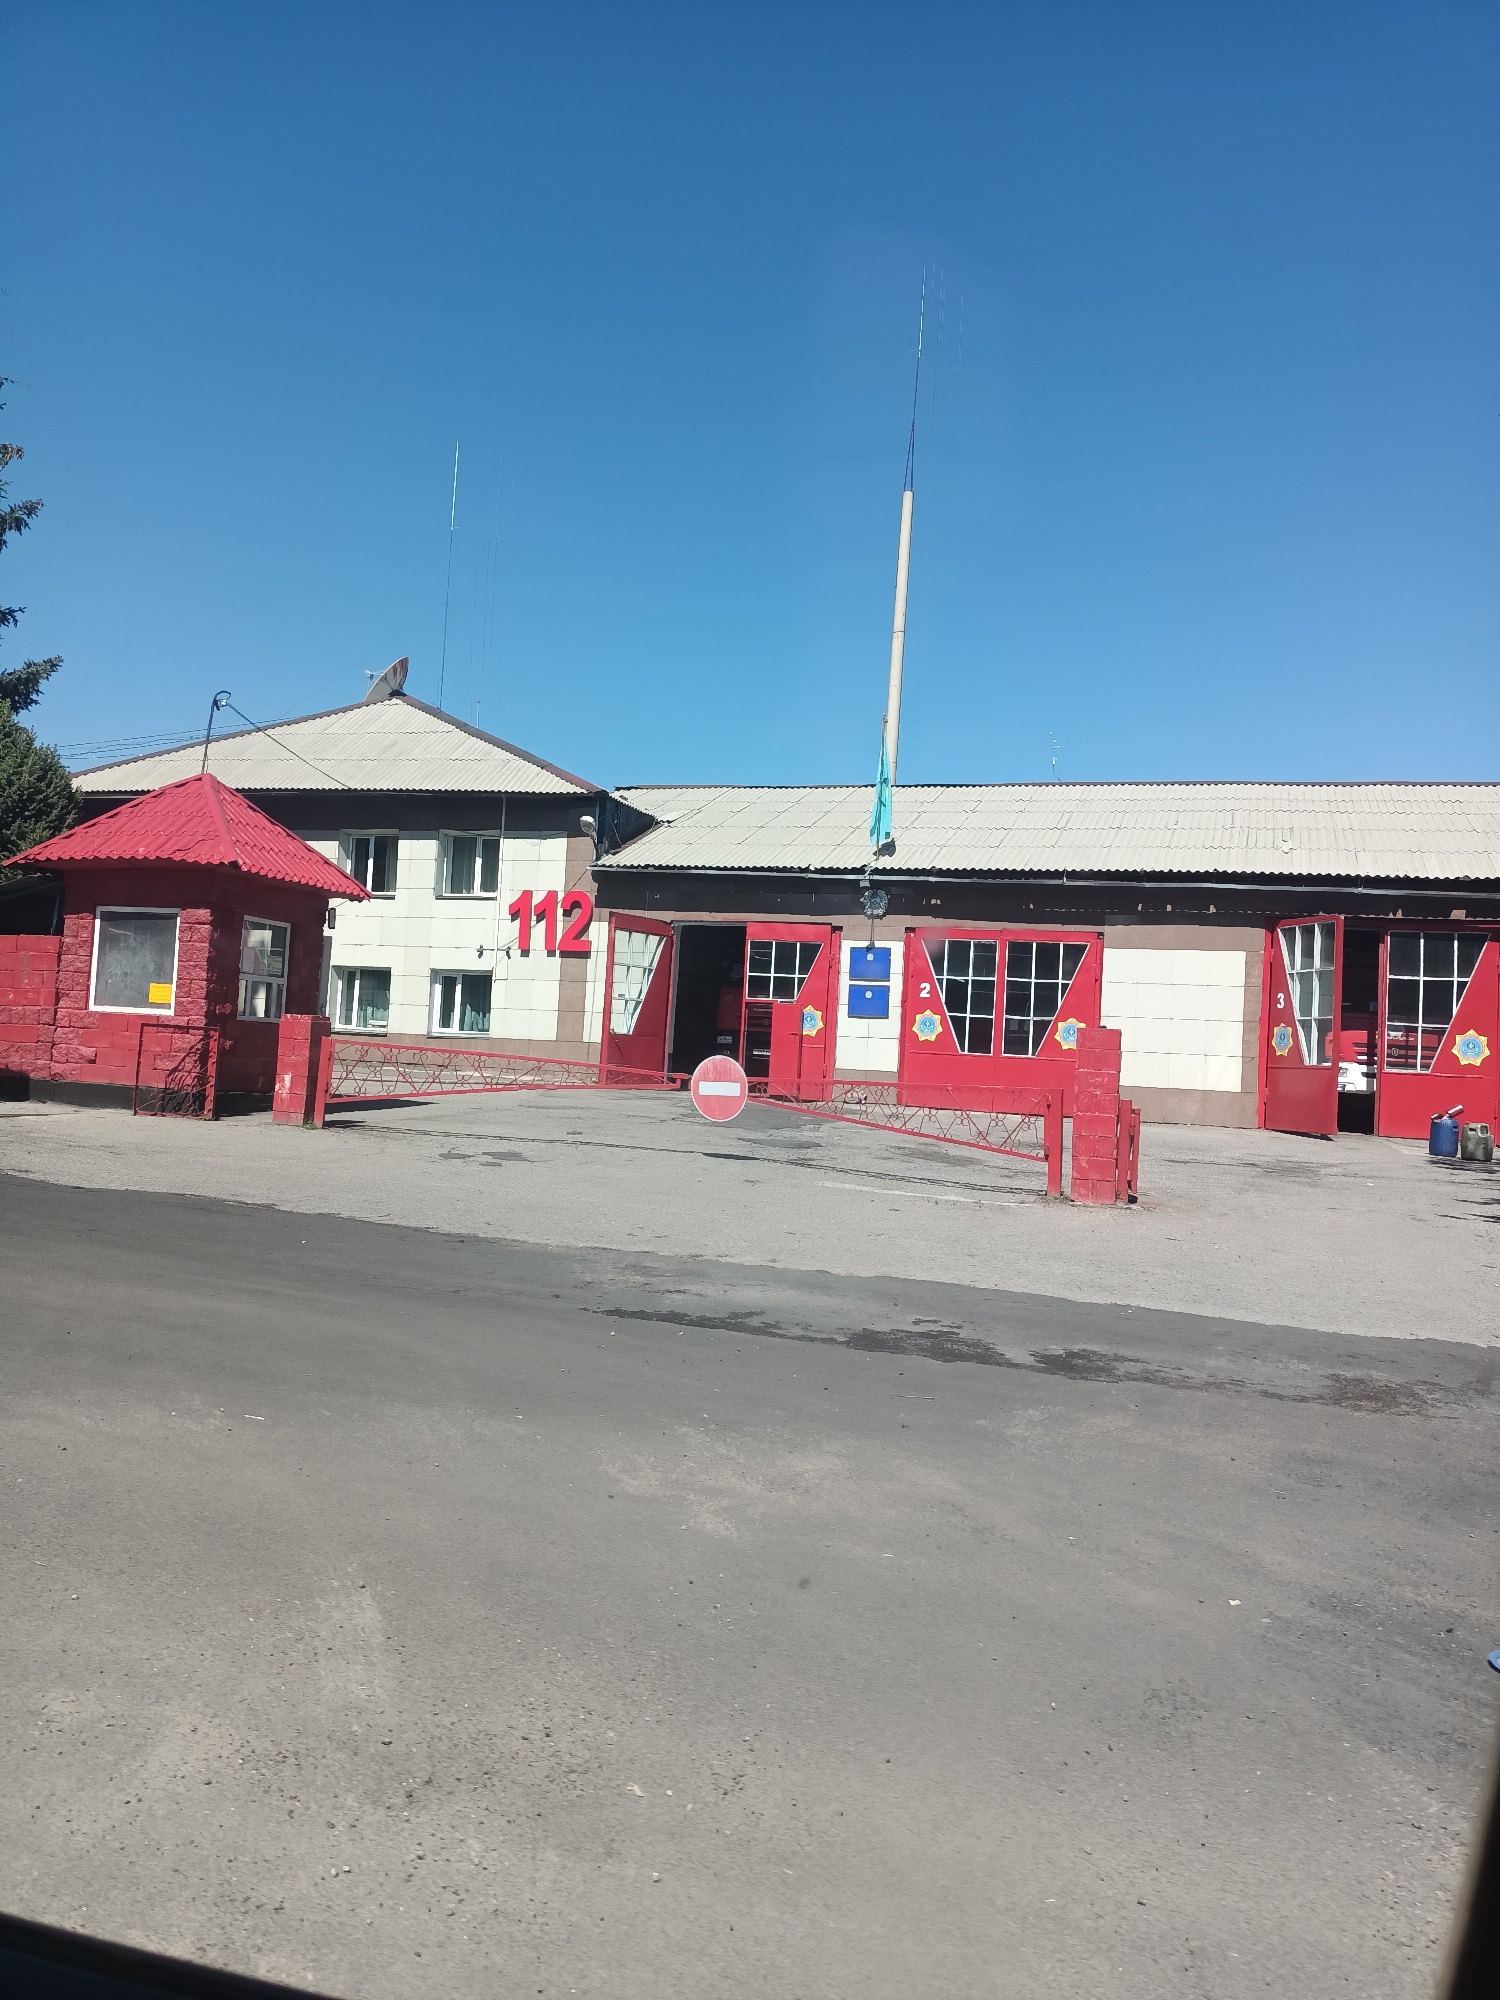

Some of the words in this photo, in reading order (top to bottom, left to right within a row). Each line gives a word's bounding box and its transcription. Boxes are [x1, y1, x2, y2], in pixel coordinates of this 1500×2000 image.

[508, 889, 593, 951] 112
[919, 982, 931, 998] 2
[1276, 992, 1285, 1009] 3
